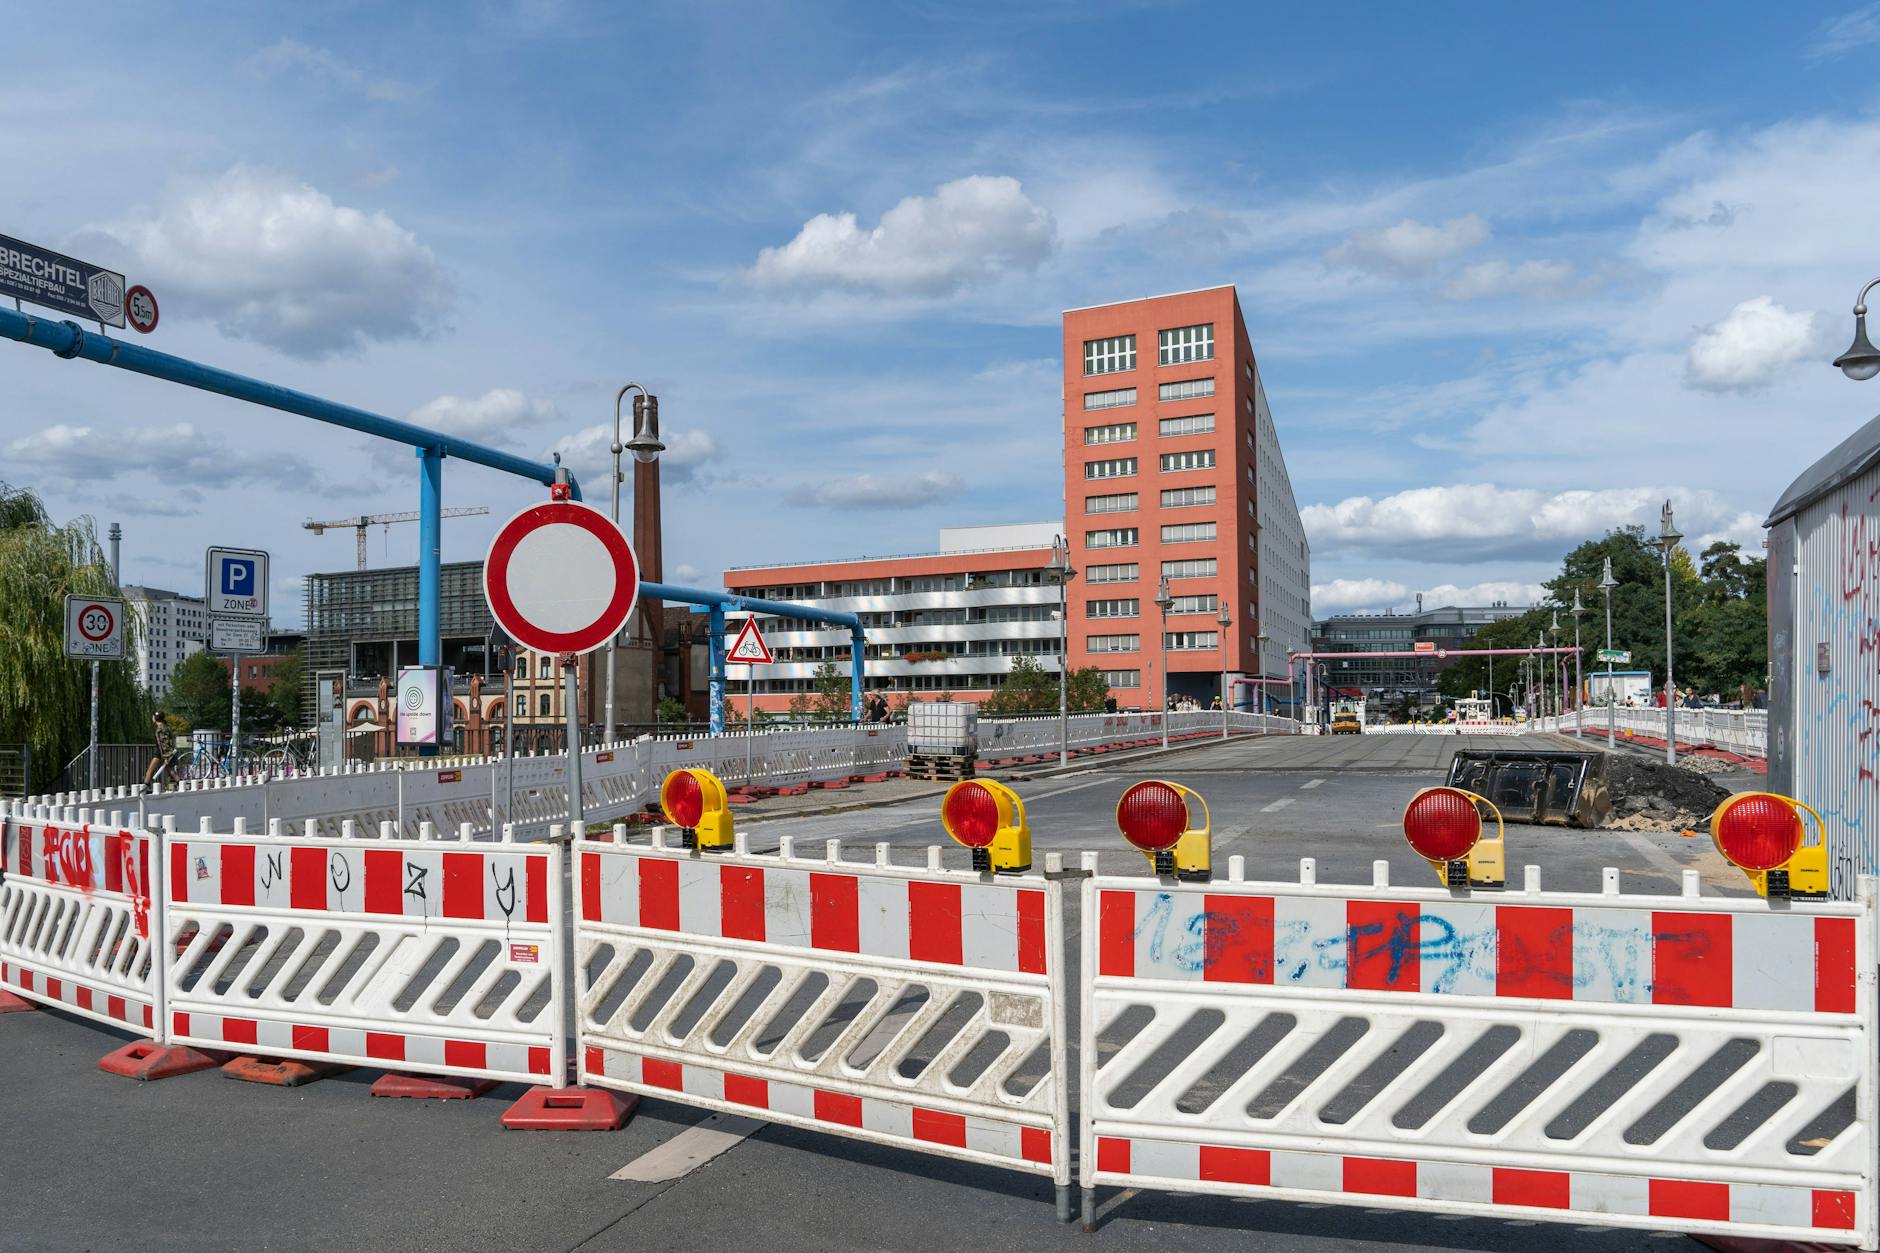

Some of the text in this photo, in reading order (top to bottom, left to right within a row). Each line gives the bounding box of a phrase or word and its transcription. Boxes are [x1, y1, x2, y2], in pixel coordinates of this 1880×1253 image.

[0, 246, 85, 290] BRECHTEL
[0, 266, 65, 294] SPEZIALTIEFBAU
[229, 563, 247, 590] P
[223, 599, 251, 611] ZONE
[86, 614, 107, 631] 30
